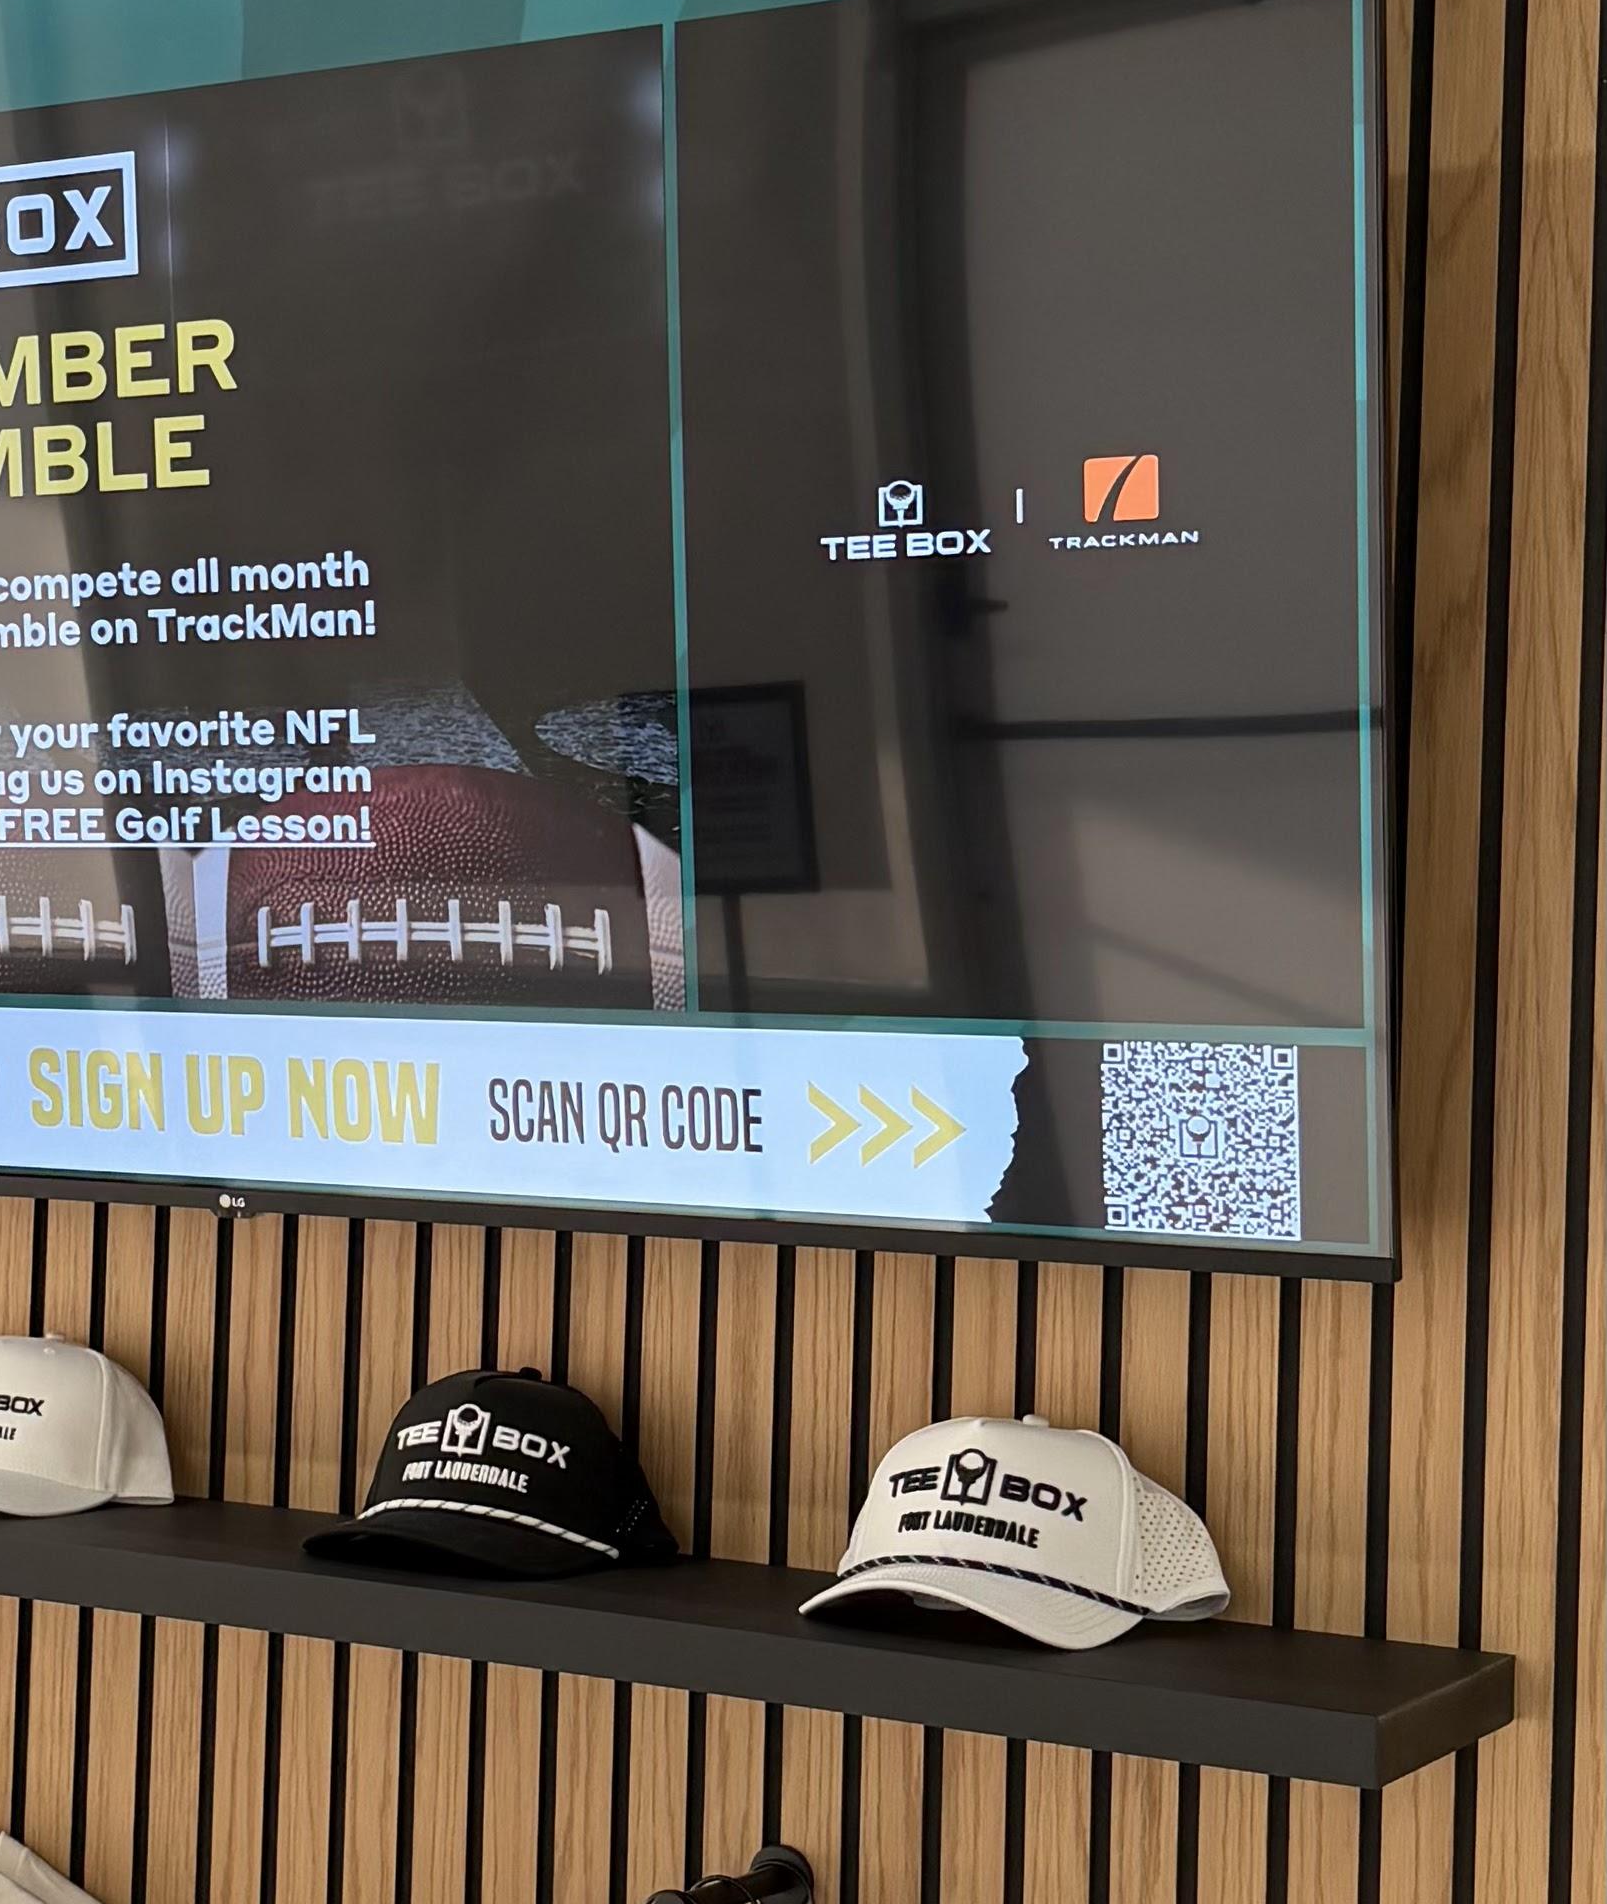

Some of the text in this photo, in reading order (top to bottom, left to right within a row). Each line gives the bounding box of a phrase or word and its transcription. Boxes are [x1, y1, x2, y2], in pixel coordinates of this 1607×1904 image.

[820, 528, 992, 561] TEE BOX
[1048, 530, 1199, 550] TRACKMAN
[171, 556, 219, 594] all
[230, 550, 369, 592] month
[90, 618, 138, 645] on
[147, 599, 376, 643] TrackMan!
[9, 722, 99, 759] your
[106, 710, 275, 748] favorite
[286, 708, 377, 745] NFL
[40, 769, 85, 795] us
[93, 768, 142, 795] on
[152, 759, 372, 802] Instagram
[115, 807, 202, 841] Golf
[210, 806, 372, 840] Lesson!
[29, 1048, 165, 1131] SIGN
[185, 1054, 264, 1135] UP
[288, 1058, 439, 1144] NOW
[489, 1078, 585, 1144] SCAN
[598, 1082, 648, 1153] QR
[661, 1084, 763, 1153] CODE
[231, 1196, 246, 1208] LG
[397, 1420, 571, 1469] TEE BOX
[434, 1459, 530, 1494] LAUDERDALE
[889, 1466, 1088, 1523] TEE BOX
[933, 1509, 1041, 1549] LAUDERDALE
